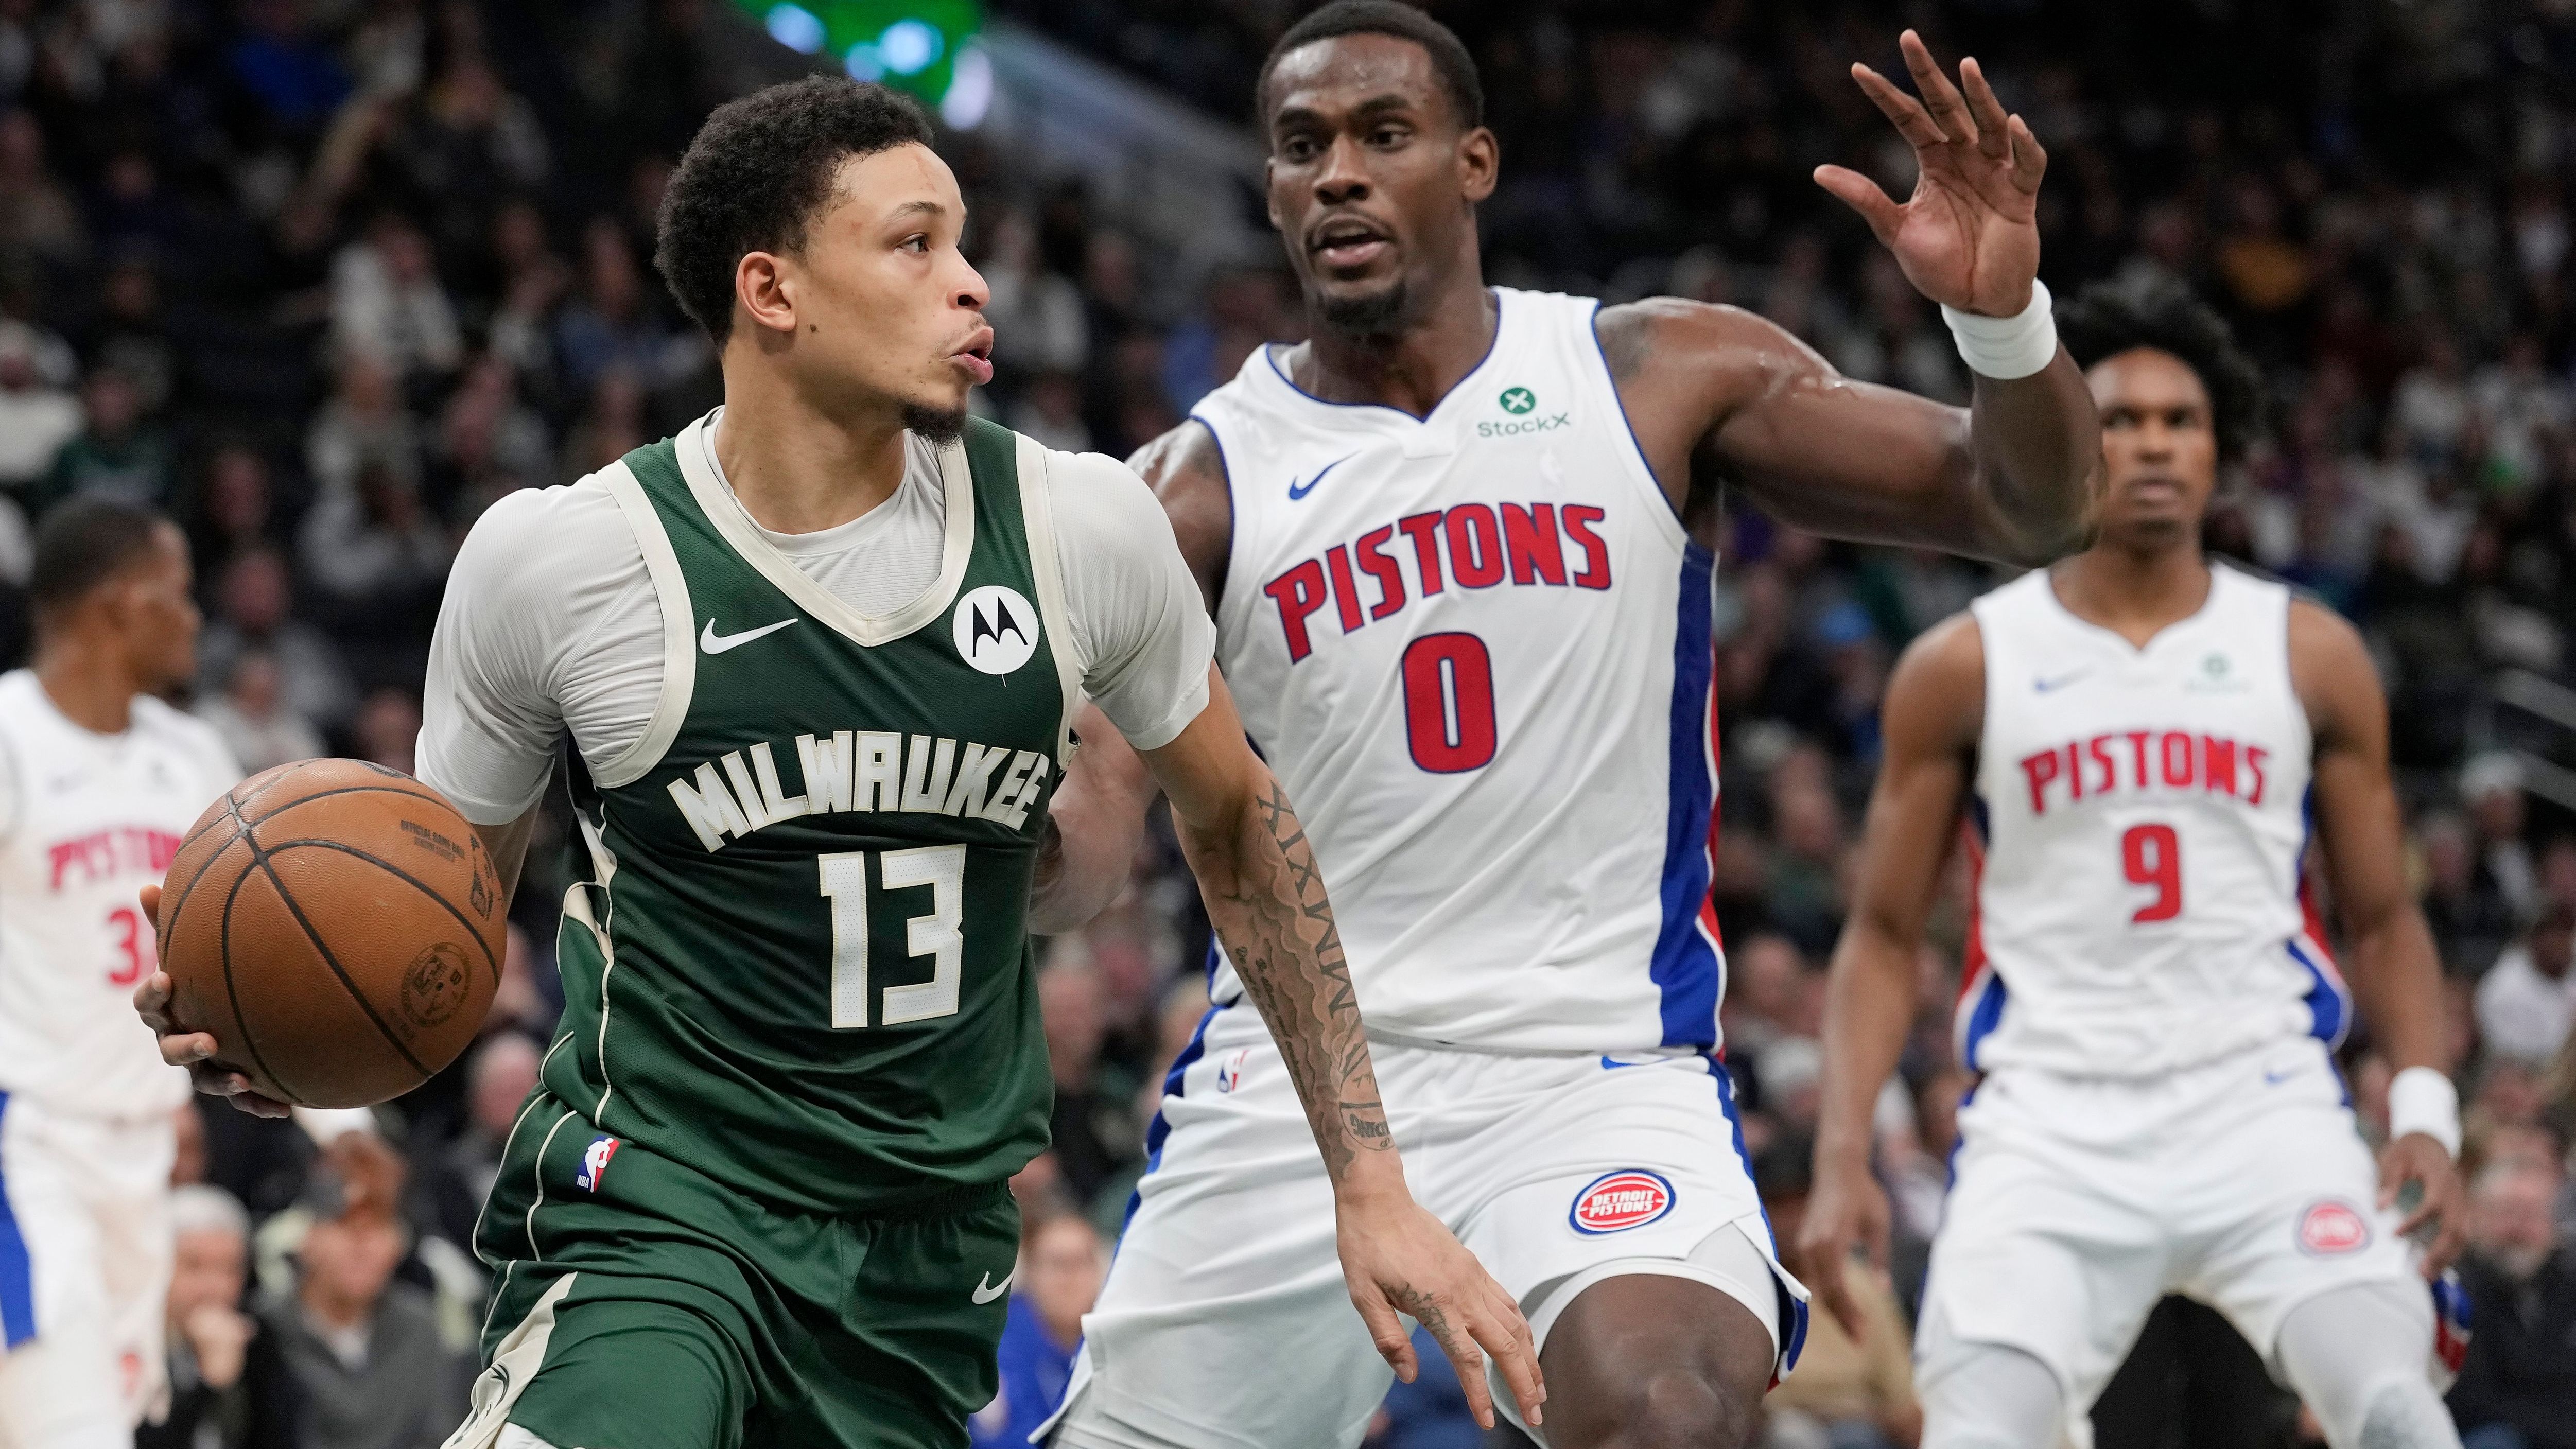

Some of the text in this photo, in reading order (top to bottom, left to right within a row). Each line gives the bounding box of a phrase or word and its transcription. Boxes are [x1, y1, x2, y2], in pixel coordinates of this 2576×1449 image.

[1478, 412, 1570, 437] StockX
[1264, 502, 1612, 664] PISTONS
[1401, 632, 1498, 774] 0
[667, 730, 1049, 853] MILWAUKEE
[2018, 731, 2269, 815] PISTONS
[2121, 822, 2183, 925] 9
[109, 907, 152, 988] 3
[819, 843, 967, 1029] 13
[577, 1174, 590, 1189] NBA
[1588, 1201, 1654, 1218] PISTONS
[1591, 1189, 1656, 1208] DETROIT
